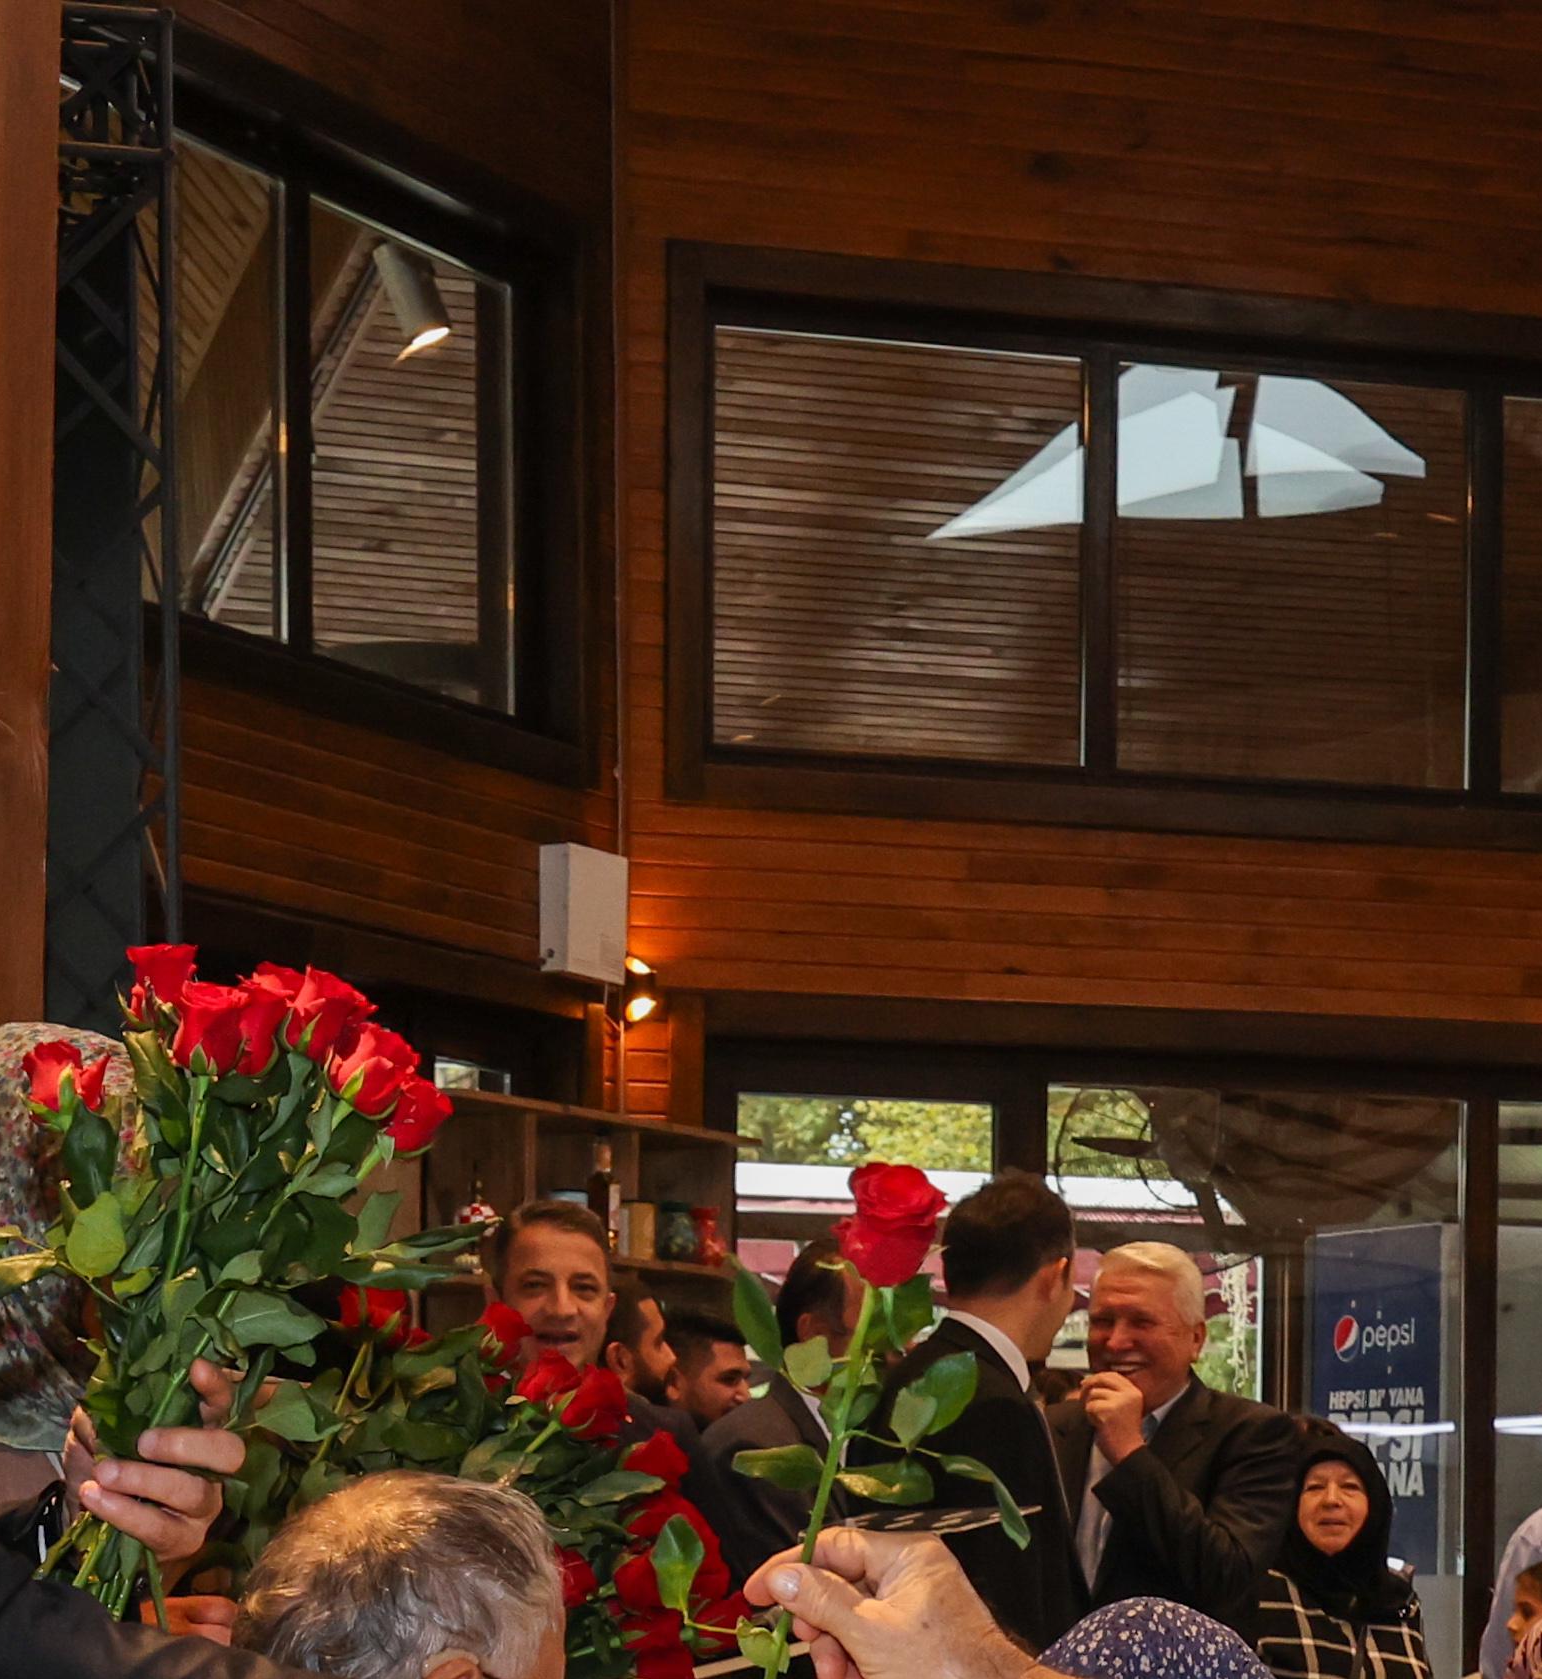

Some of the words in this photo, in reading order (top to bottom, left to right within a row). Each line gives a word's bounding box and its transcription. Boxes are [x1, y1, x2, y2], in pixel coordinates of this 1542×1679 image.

[1362, 1317, 1415, 1355] pepsi
[1388, 1386, 1425, 1408] YANA
[1328, 1409, 1425, 1462] PSI
[1380, 1461, 1425, 1497] NA
